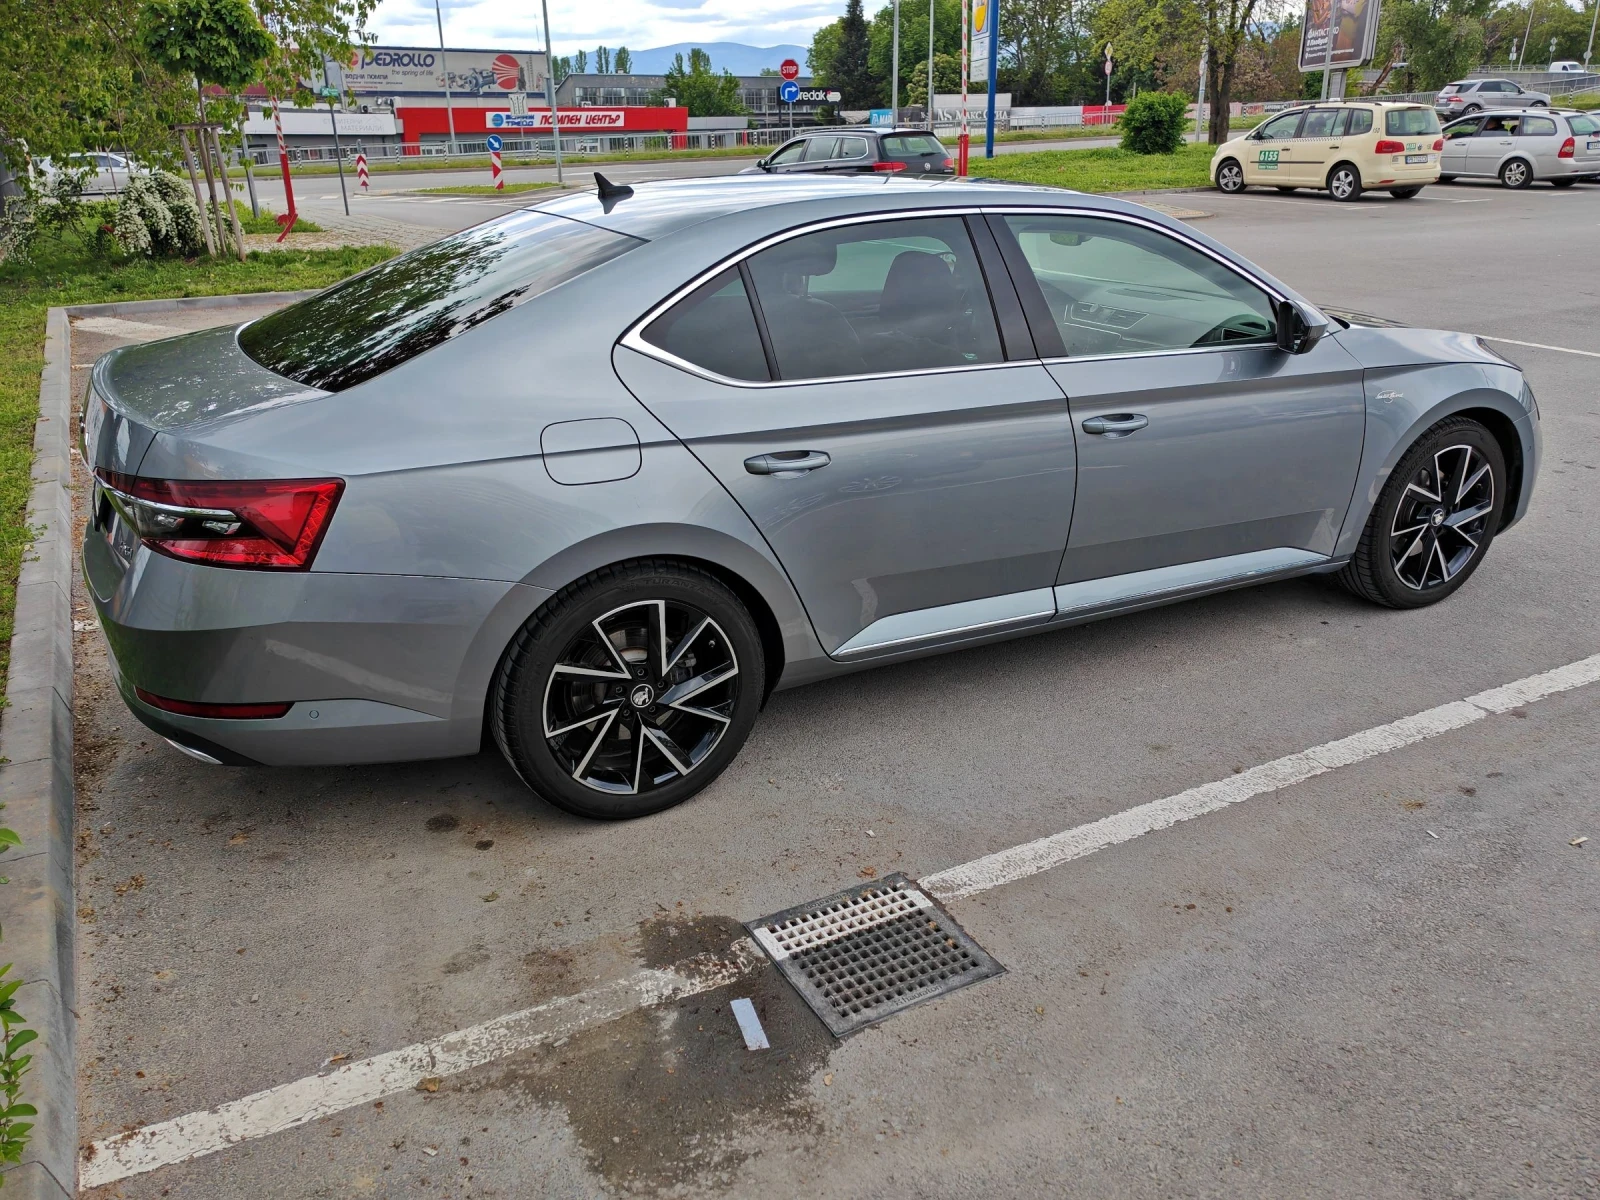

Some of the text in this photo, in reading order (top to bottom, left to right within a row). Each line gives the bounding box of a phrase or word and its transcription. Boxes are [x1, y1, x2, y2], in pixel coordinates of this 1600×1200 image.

[401, 70, 418, 78] spring
[782, 65, 797, 74] STOP
[587, 114, 625, 126] ЦЕНТЪР
[1259, 151, 1279, 161] 6155
[644, 578, 706, 594] TURANZA
[901, 985, 943, 1003] hauraton
